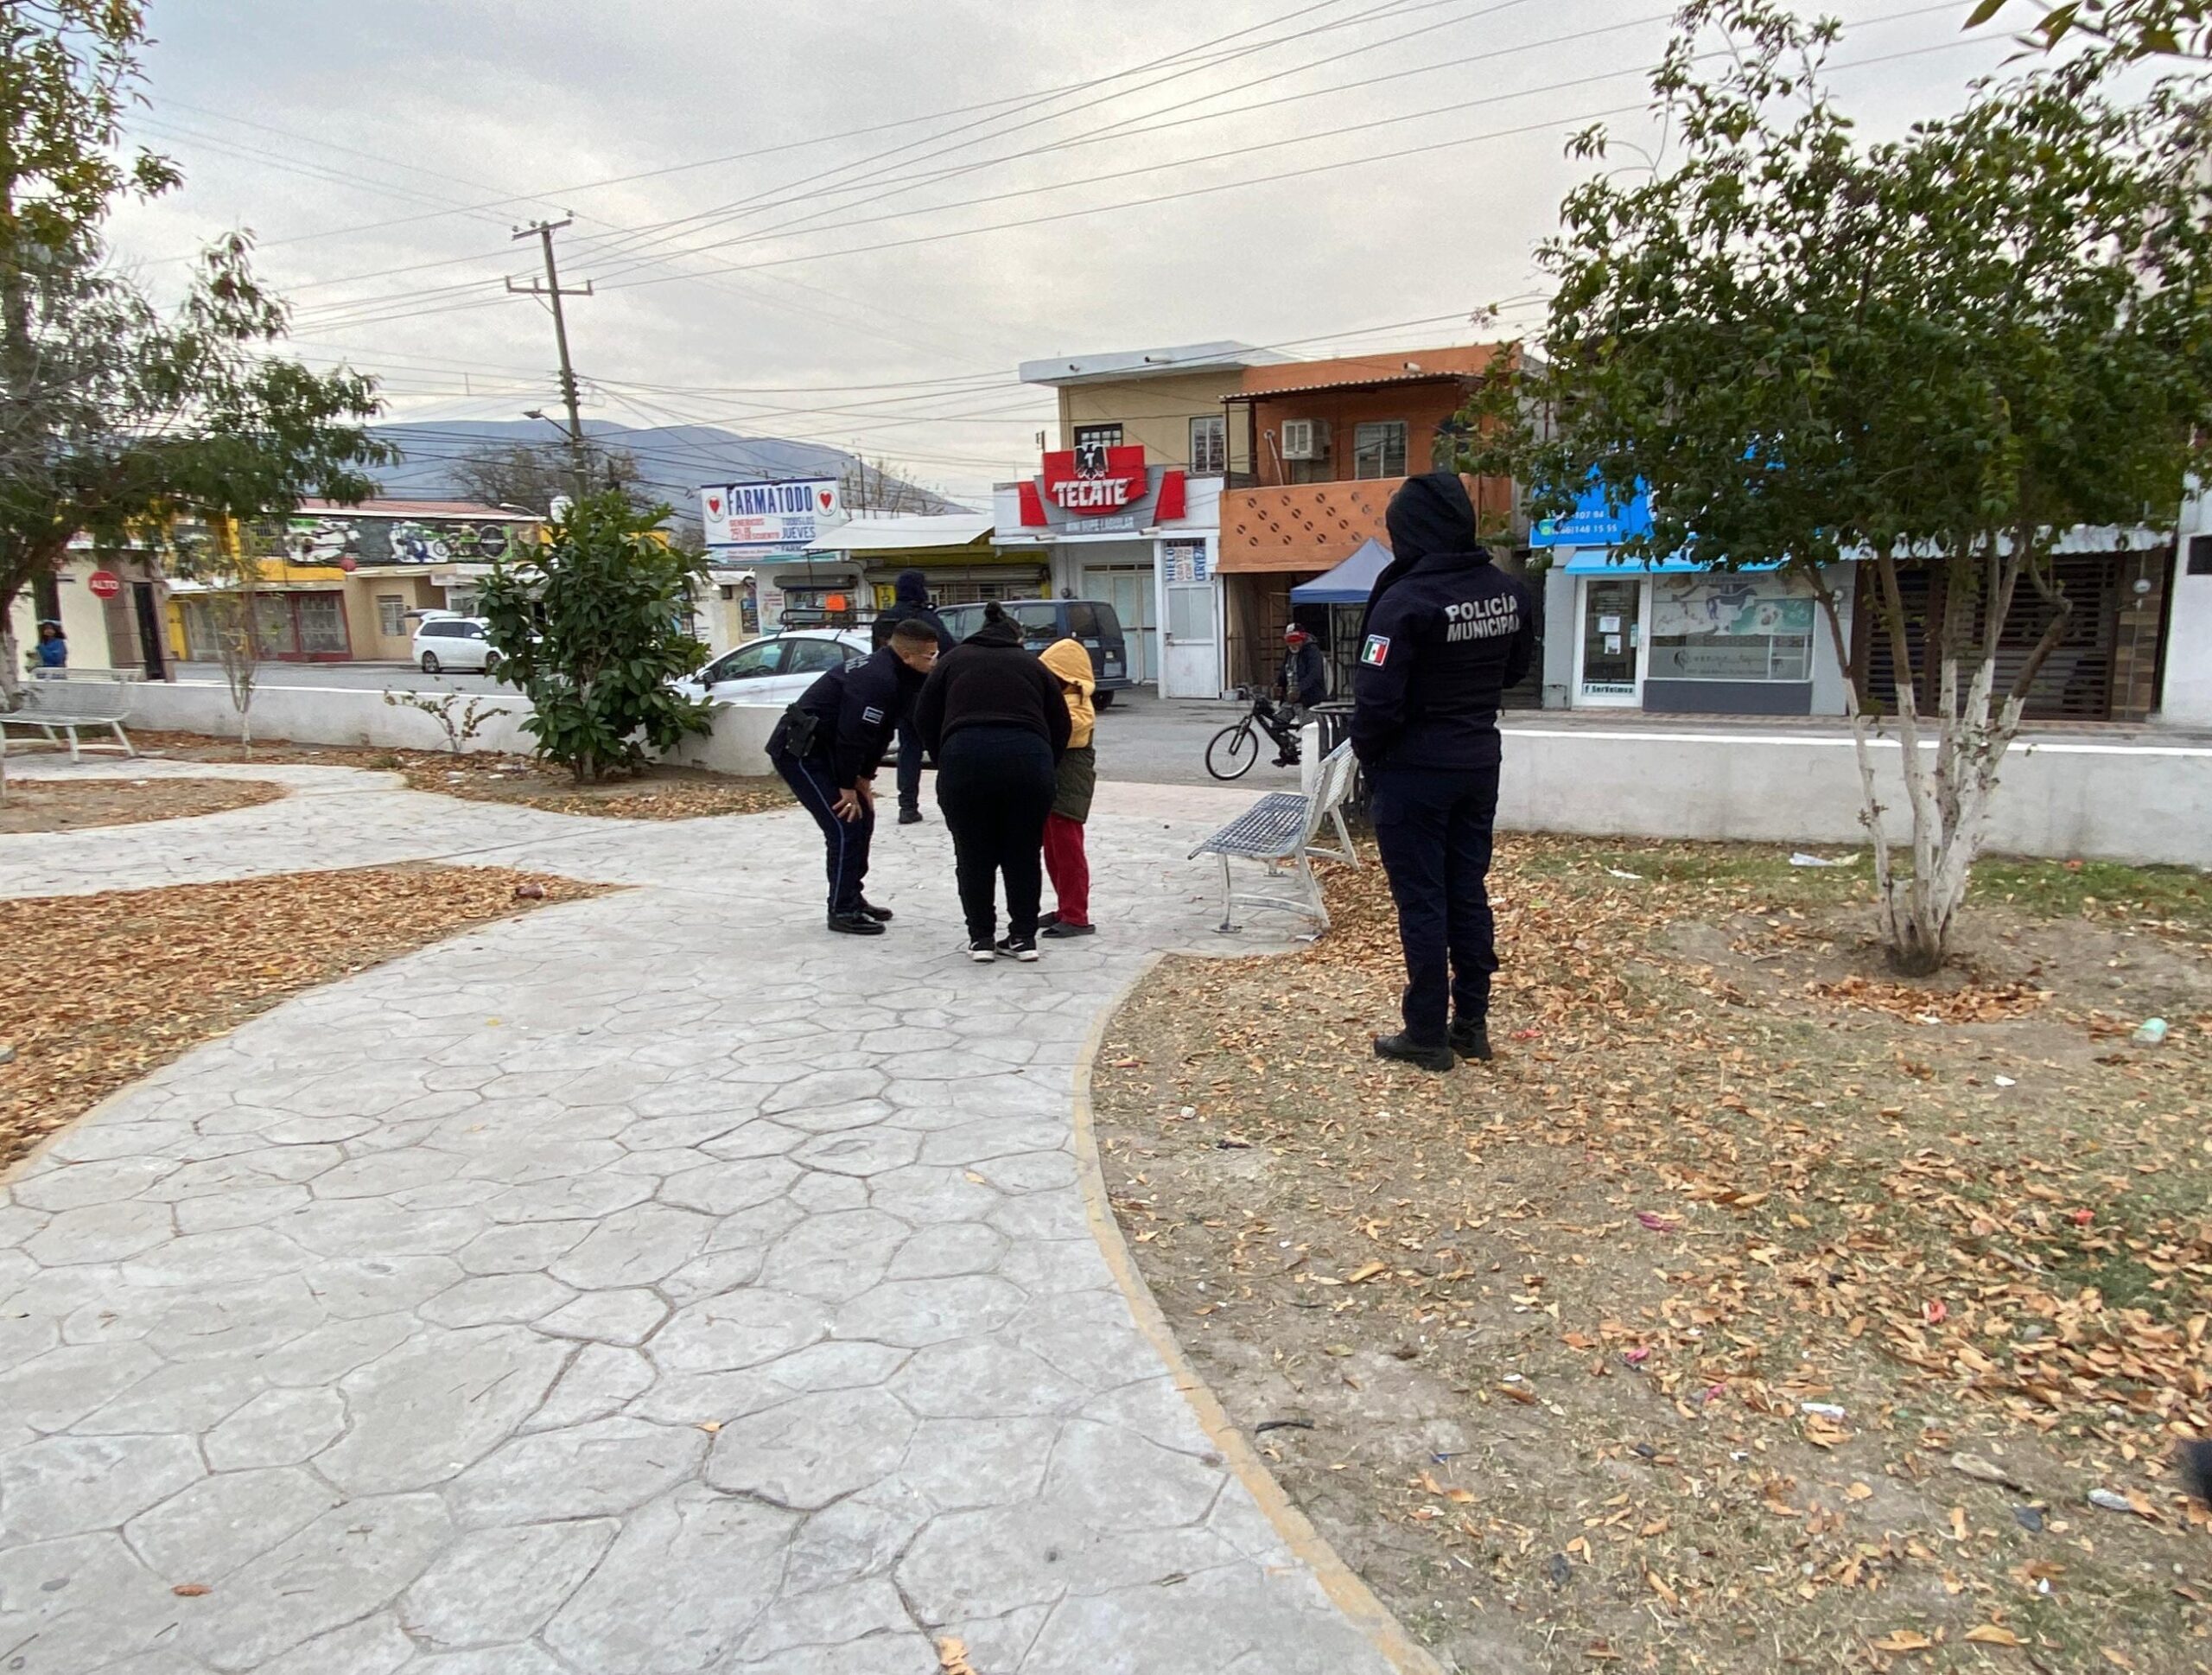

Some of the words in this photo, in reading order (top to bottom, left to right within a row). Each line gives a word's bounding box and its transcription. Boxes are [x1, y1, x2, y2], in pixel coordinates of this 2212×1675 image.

[727, 486, 813, 515] FARMATODO
[1052, 478, 1131, 507] TECATE
[781, 526, 816, 539] JUEVES
[781, 545, 803, 553] FARM
[1166, 548, 1175, 582] HIELO
[91, 580, 119, 589] ALTO
[1444, 592, 1518, 622] POLICÍA
